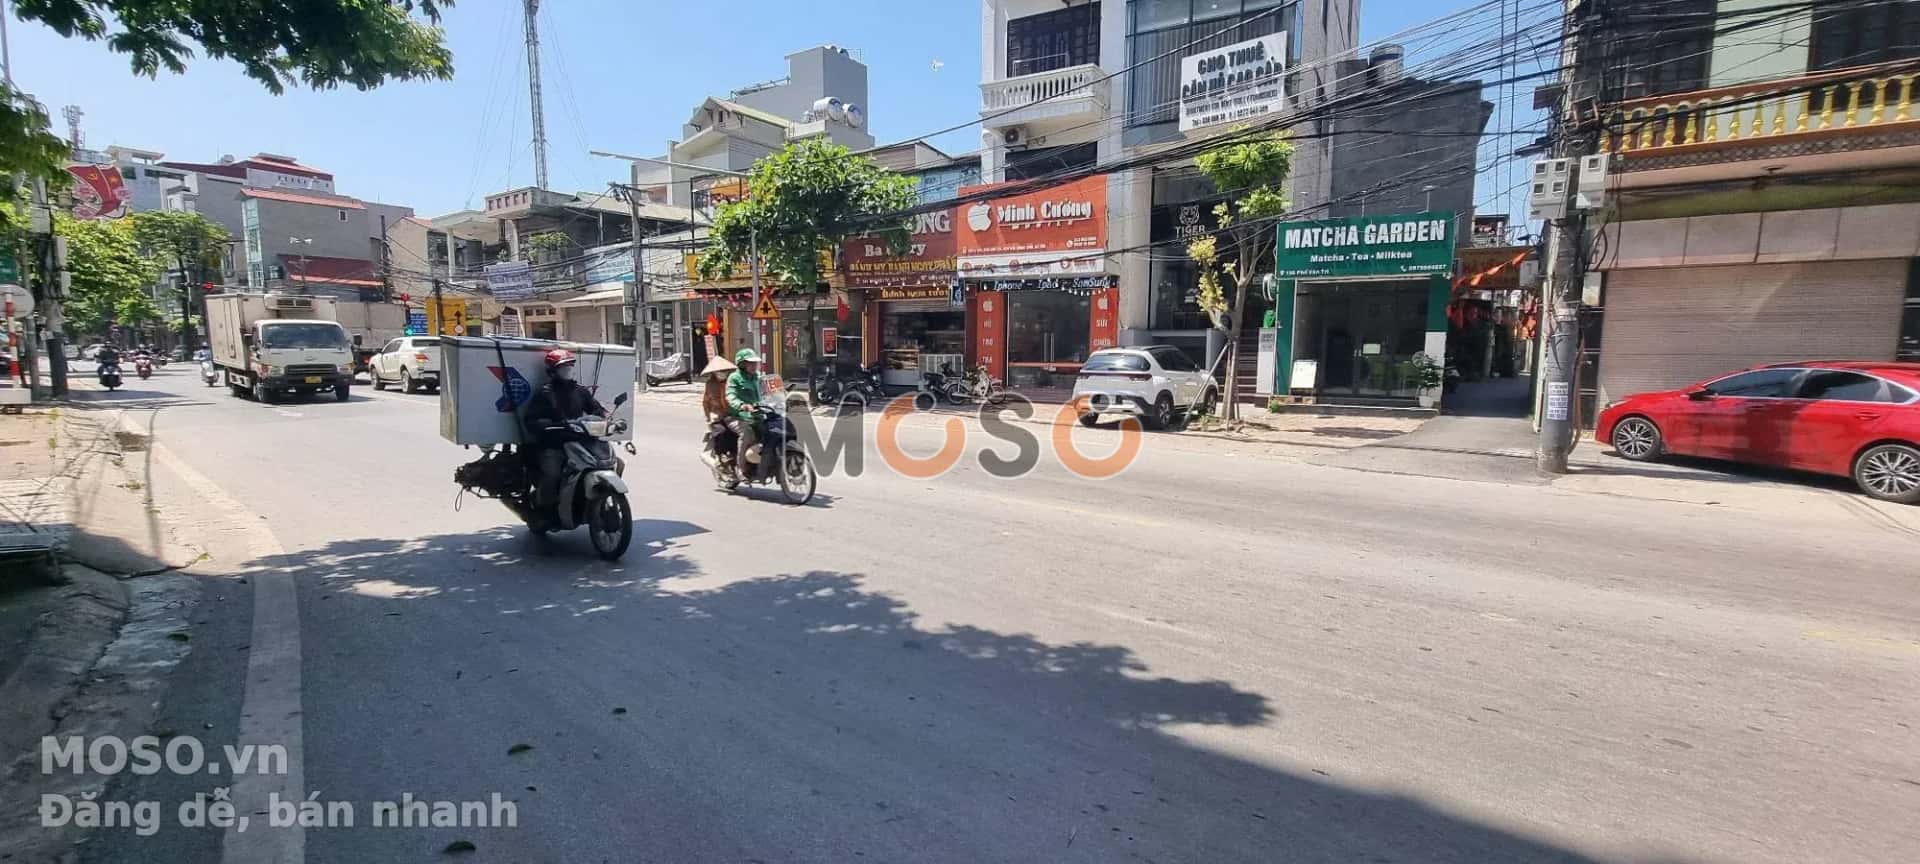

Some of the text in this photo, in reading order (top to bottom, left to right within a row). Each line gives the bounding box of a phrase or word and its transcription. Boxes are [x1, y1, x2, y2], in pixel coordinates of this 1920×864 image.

[1198, 54, 1225, 74] CHO
[998, 203, 1035, 222] Minh
[1285, 220, 1446, 249] MATCHA GARDEN
[1310, 252, 1412, 263] Matcha Tea Milktea
